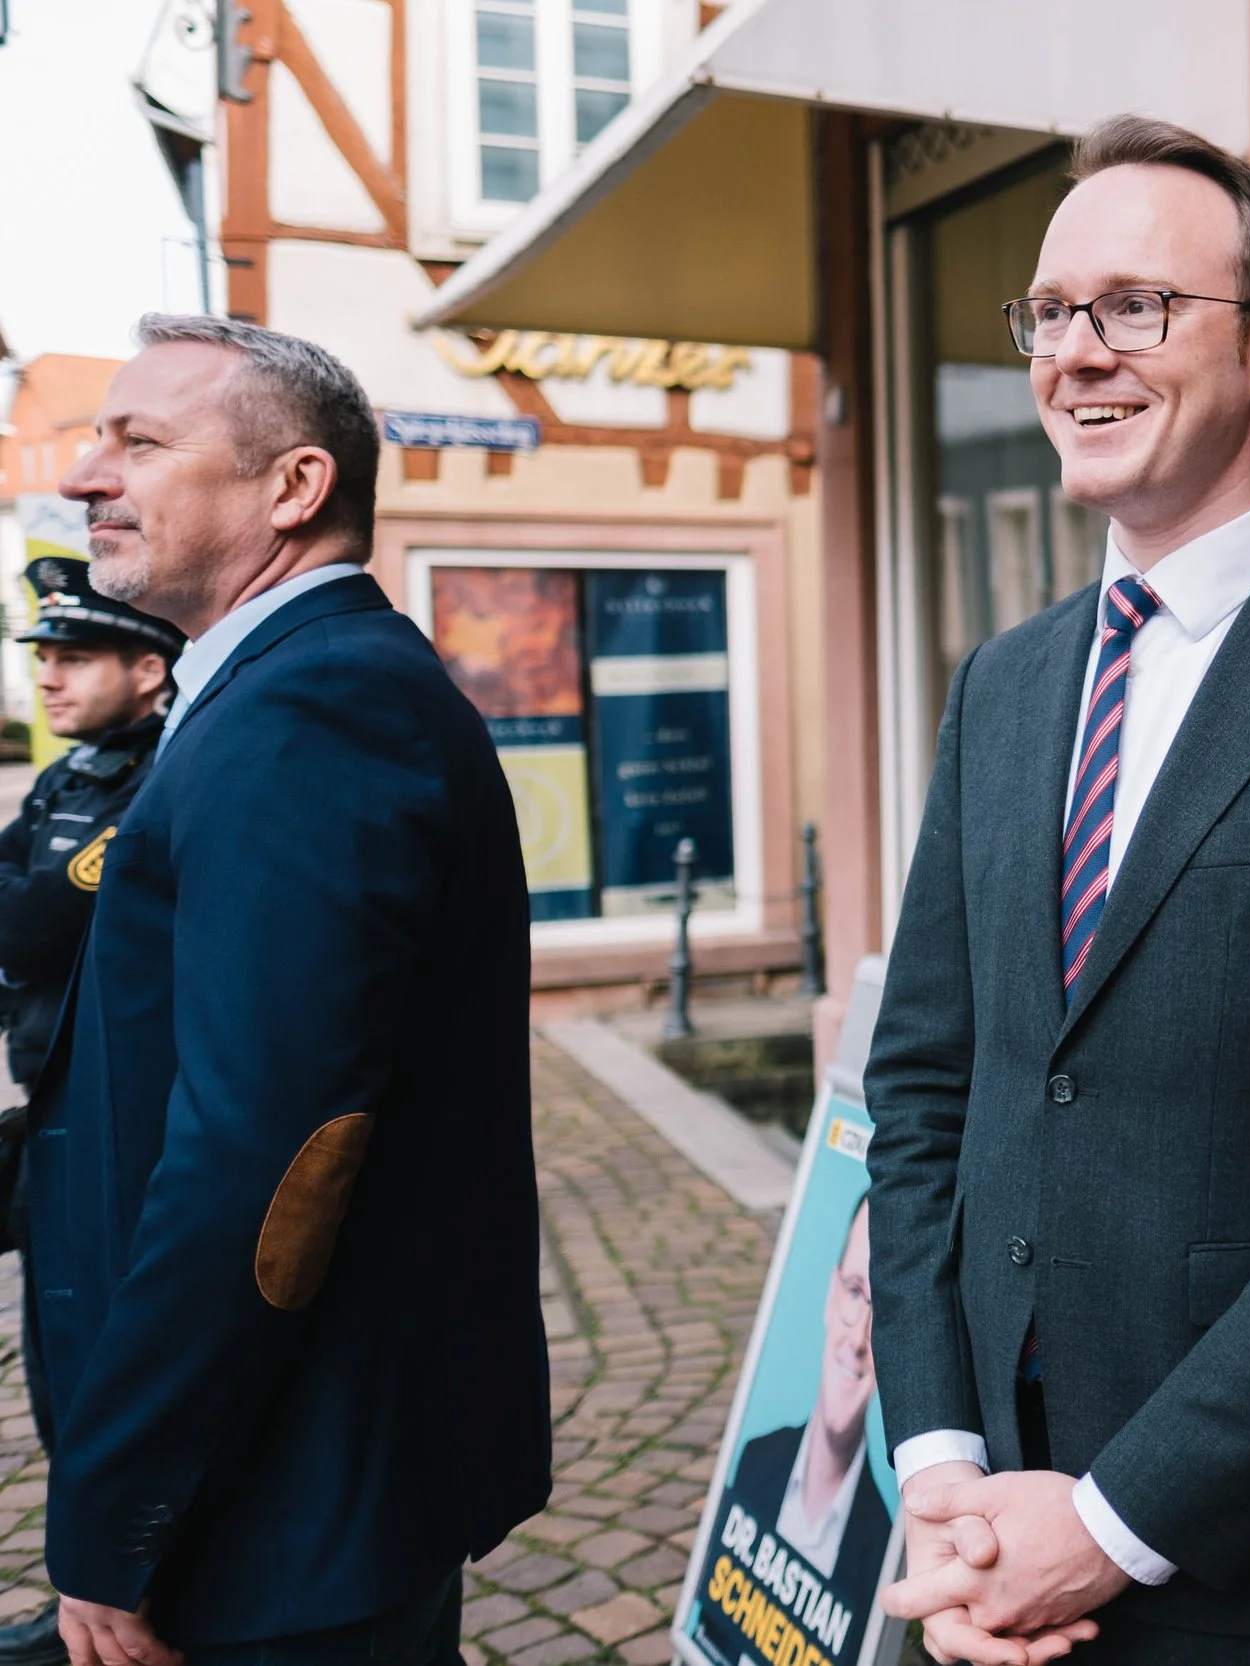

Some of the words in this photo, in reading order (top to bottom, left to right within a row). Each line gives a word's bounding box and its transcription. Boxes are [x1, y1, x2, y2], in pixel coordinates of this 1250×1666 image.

[708, 1554, 834, 1666] SCHNEID
[721, 1503, 758, 1568] DR.
[752, 1532, 852, 1656] BASTIAN
